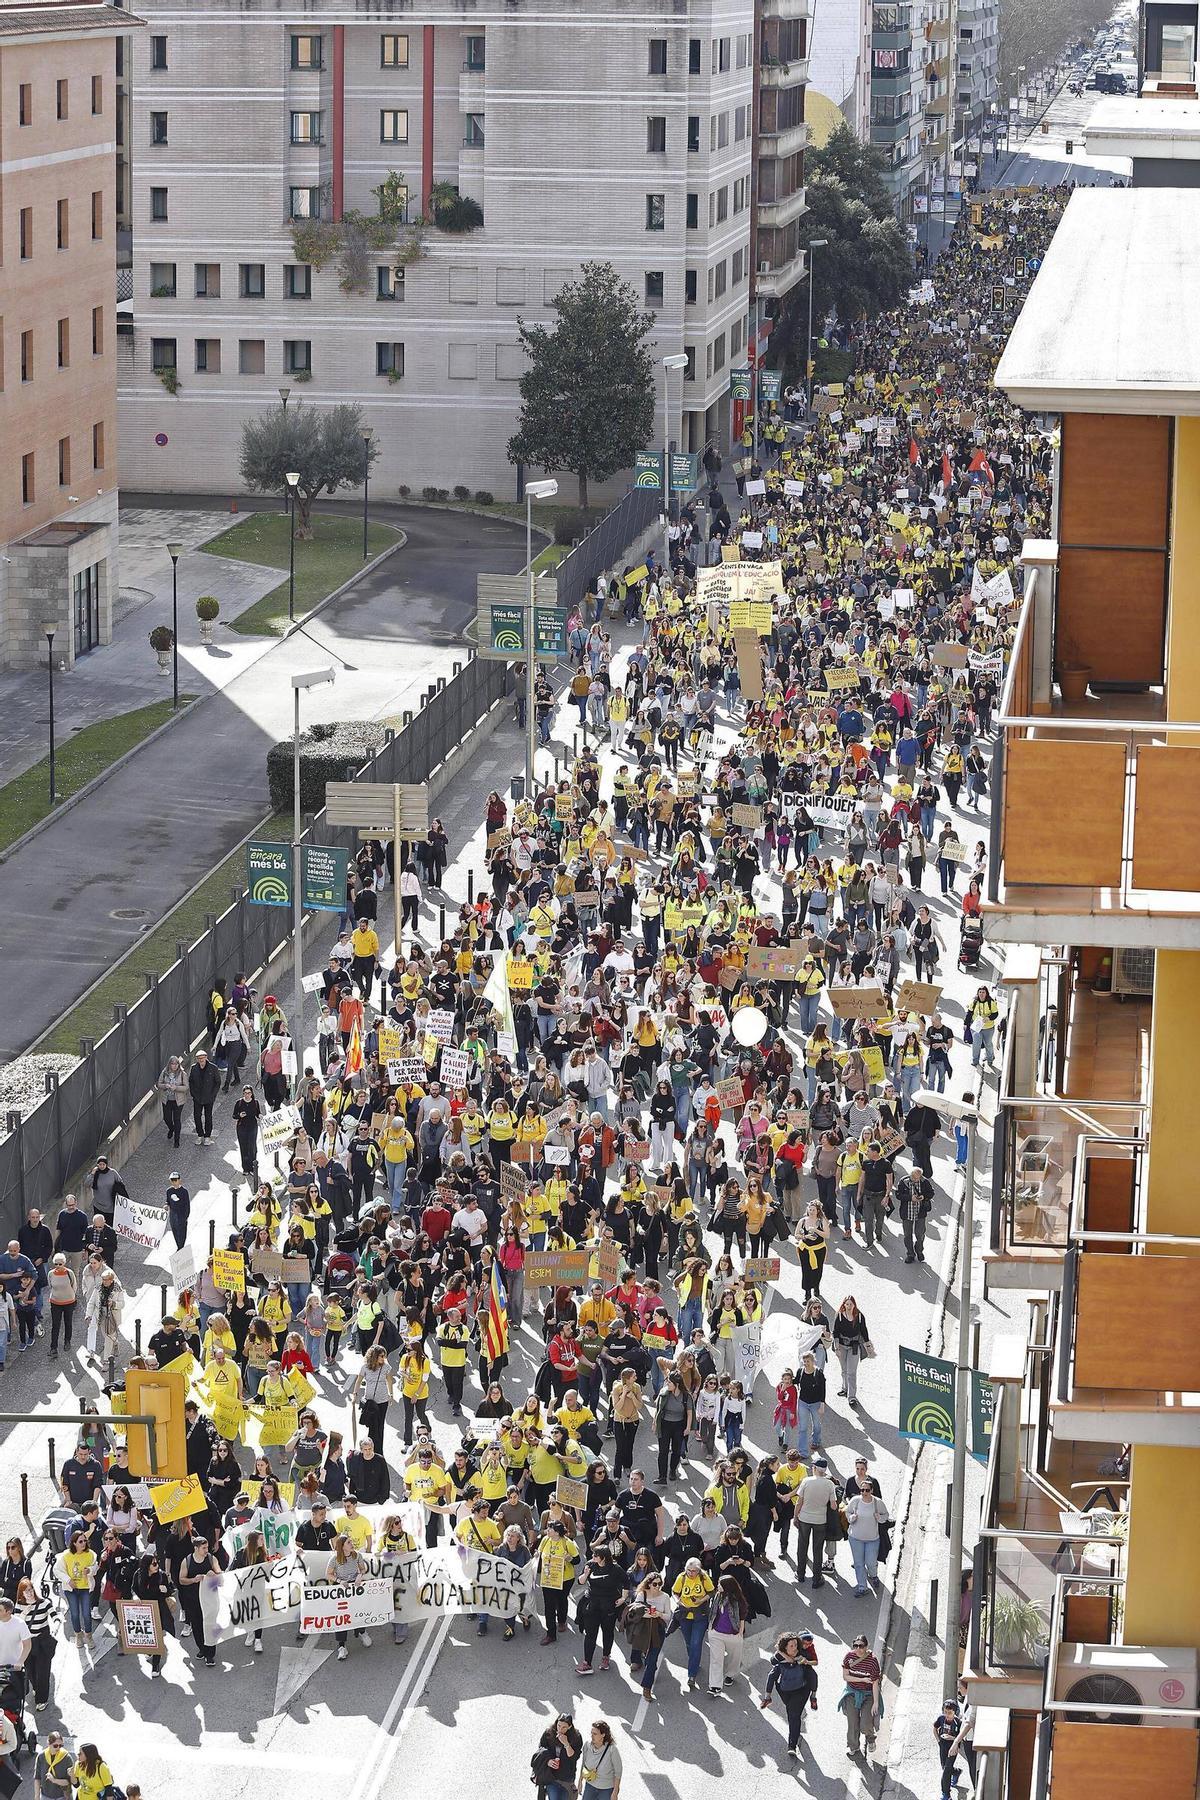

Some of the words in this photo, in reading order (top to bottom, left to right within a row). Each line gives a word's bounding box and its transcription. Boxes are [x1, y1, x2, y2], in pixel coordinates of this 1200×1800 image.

[784, 794, 856, 813] DIGNIFIQUEM
[250, 858, 272, 869] més
[273, 859, 287, 869] bé
[762, 962, 796, 974] TEMPS
[115, 1195, 128, 1209] NO
[529, 1268, 552, 1279] ESTEM
[904, 1363, 928, 1378] més
[929, 1367, 952, 1386] fàcil
[913, 1376, 951, 1394] l'Eixample
[234, 1554, 308, 1590] VAGA
[476, 1558, 525, 1587] PER
[304, 1582, 367, 1601] EDUCACIÓ
[228, 1594, 261, 1626] UNA
[127, 1619, 153, 1635] PAE
[303, 1614, 352, 1630] FUTUR
[1159, 1679, 1185, 1703] LG
